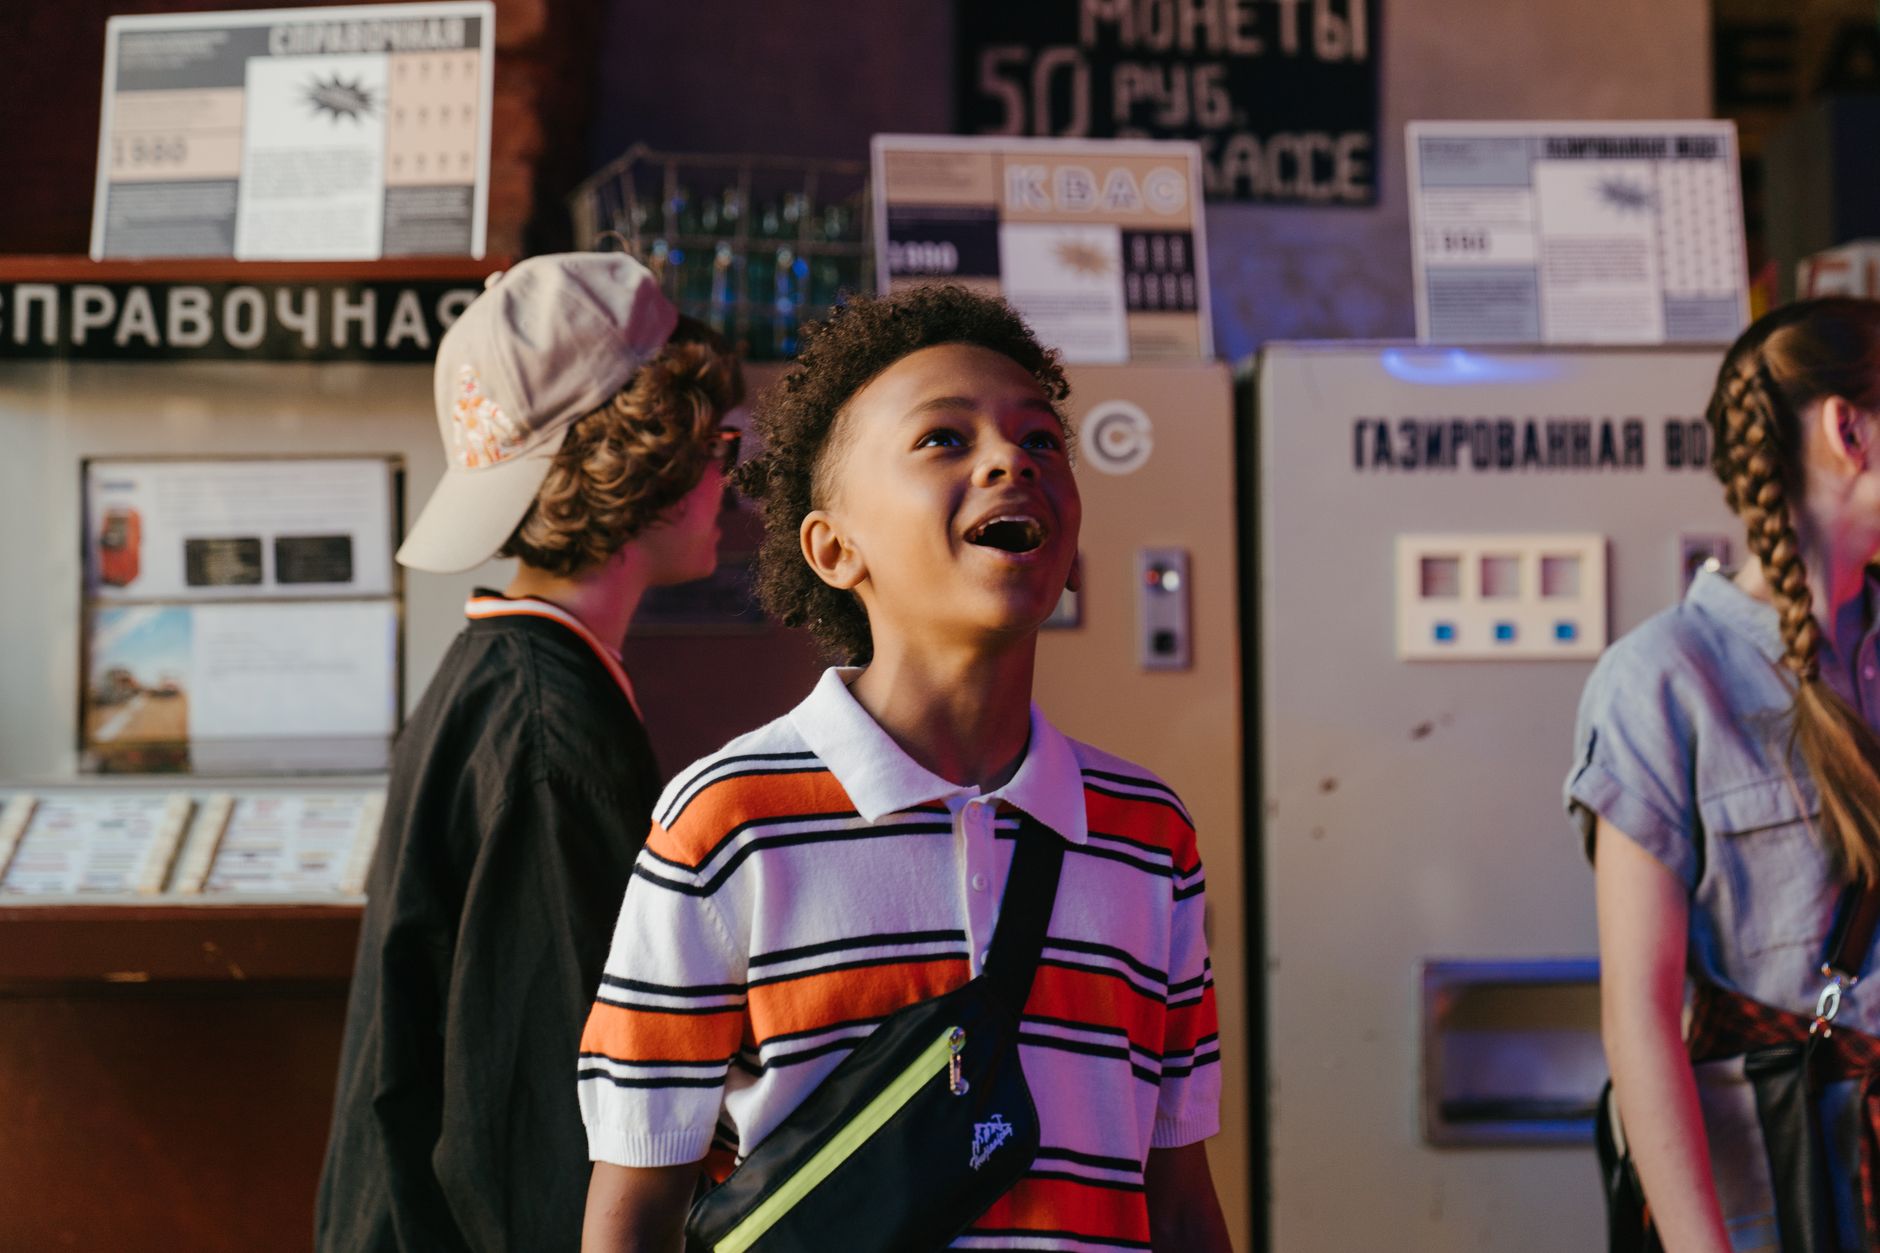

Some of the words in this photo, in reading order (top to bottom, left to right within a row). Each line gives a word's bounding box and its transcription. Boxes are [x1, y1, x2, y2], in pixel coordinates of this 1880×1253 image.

[268, 17, 465, 56] СПРАВОЧНАЯ
[978, 46, 1091, 138] 50
[1004, 164, 1188, 214] КВАС
[0, 283, 478, 348] ПРАВОЧНА
[1353, 417, 1644, 471] ГАЗИРОВАННАЯ
